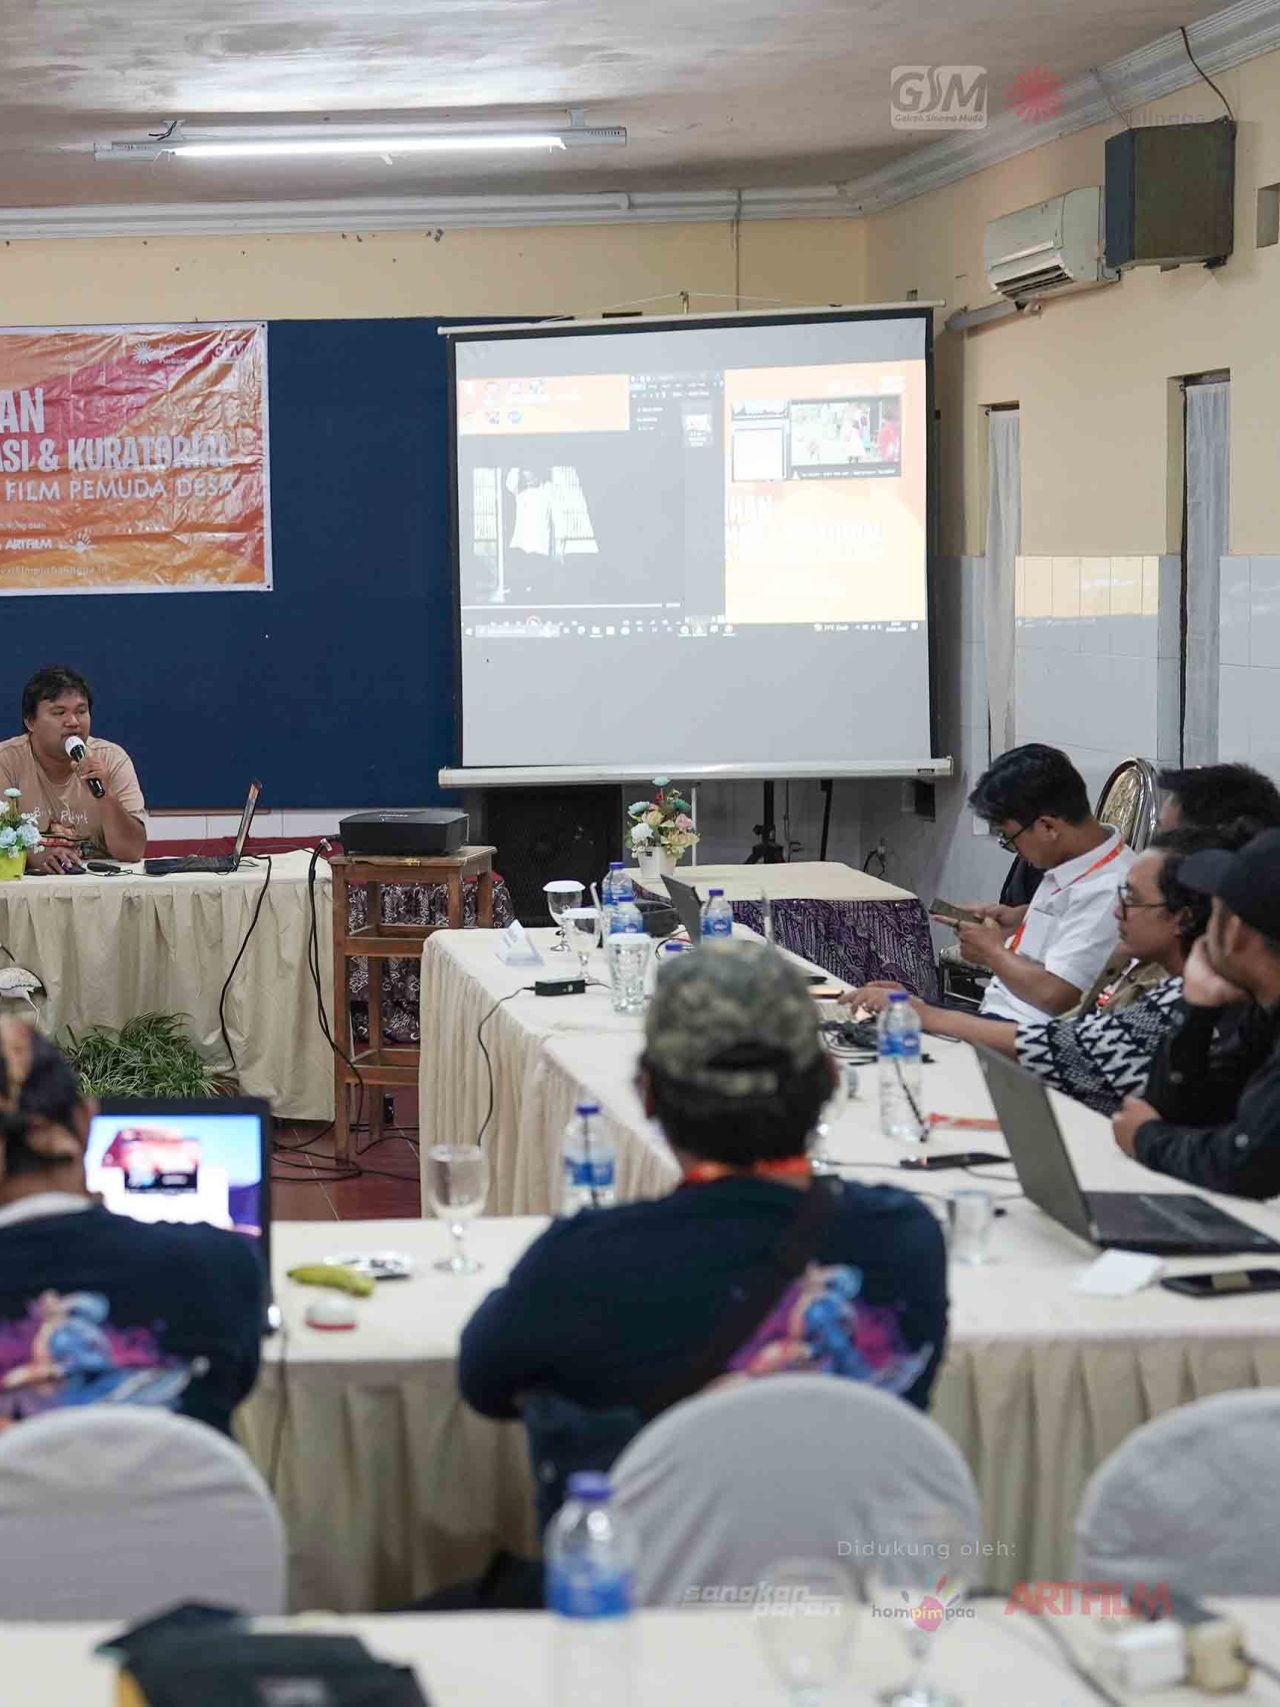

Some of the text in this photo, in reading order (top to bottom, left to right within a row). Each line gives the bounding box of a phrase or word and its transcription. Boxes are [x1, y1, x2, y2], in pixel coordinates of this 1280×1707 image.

[38, 438, 60, 473] &
[5, 480, 61, 502] FILM
[70, 478, 168, 500] PEMUDA
[175, 474, 234, 498] DESA
